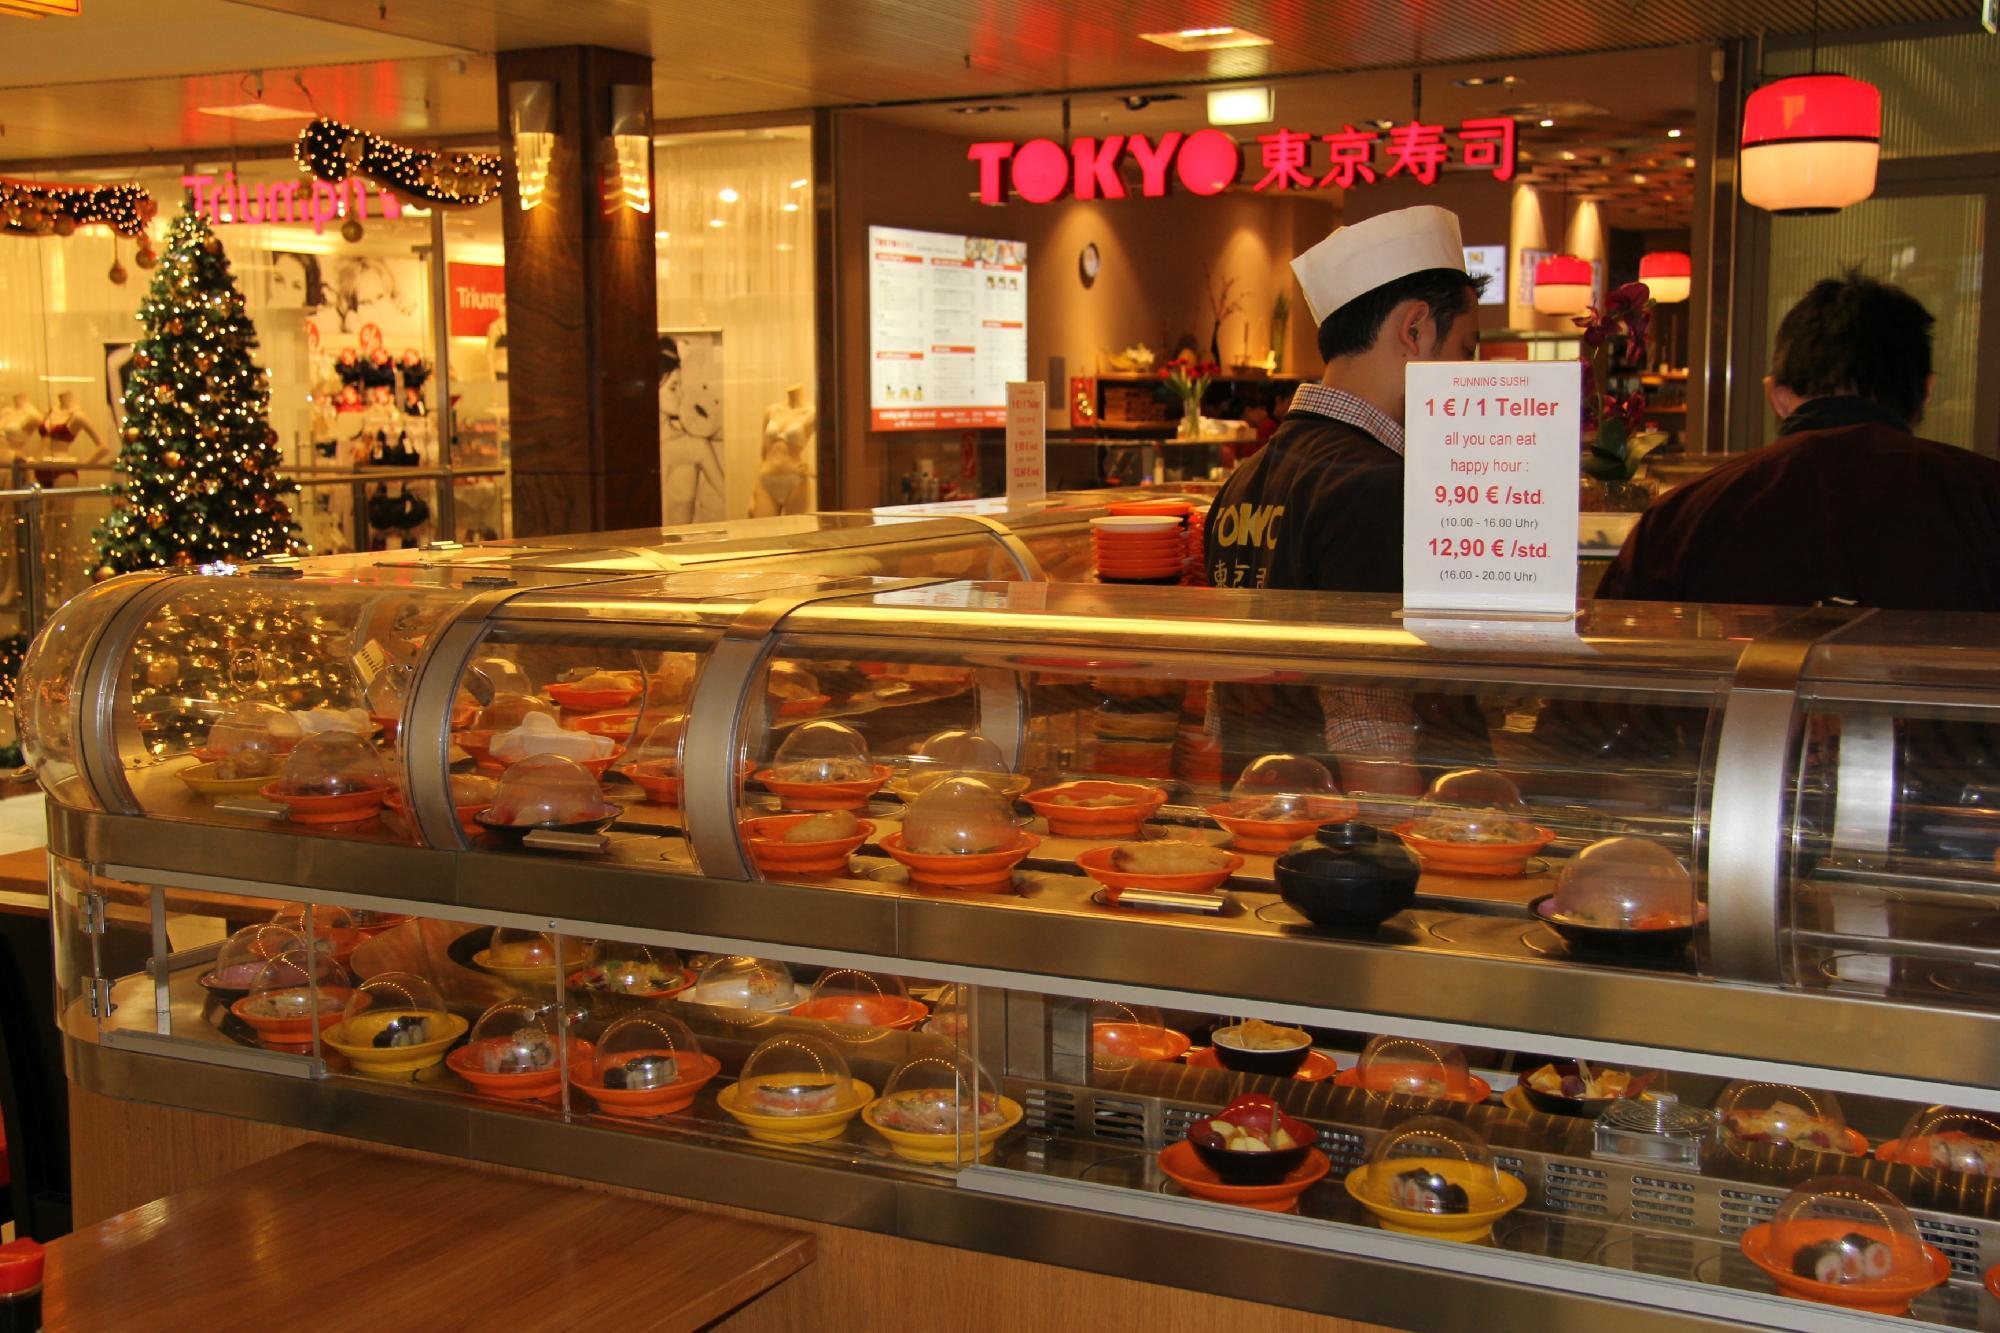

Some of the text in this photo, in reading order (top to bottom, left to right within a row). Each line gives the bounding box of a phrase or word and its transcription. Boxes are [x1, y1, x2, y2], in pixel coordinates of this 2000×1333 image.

[968, 117, 1515, 206] TOKYO 東京寿司
[1453, 376, 1529, 387] RUNNING SUSHI
[1425, 398, 1559, 417] 1 € / 1 Teller
[1445, 432, 1537, 448] all you can eat
[1450, 459, 1489, 475] happy
[1493, 459, 1522, 472] hour
[1435, 486, 1545, 507] 9,90 € /std.
[1440, 517, 1473, 529] (10.00
[1483, 518, 1512, 528] 16.00
[1515, 518, 1539, 530] Uhr)
[1429, 538, 1485, 559] 12,90
[1491, 539, 1504, 558] €
[1482, 571, 1511, 581] 20.00
[1514, 571, 1537, 583] Uhr)
